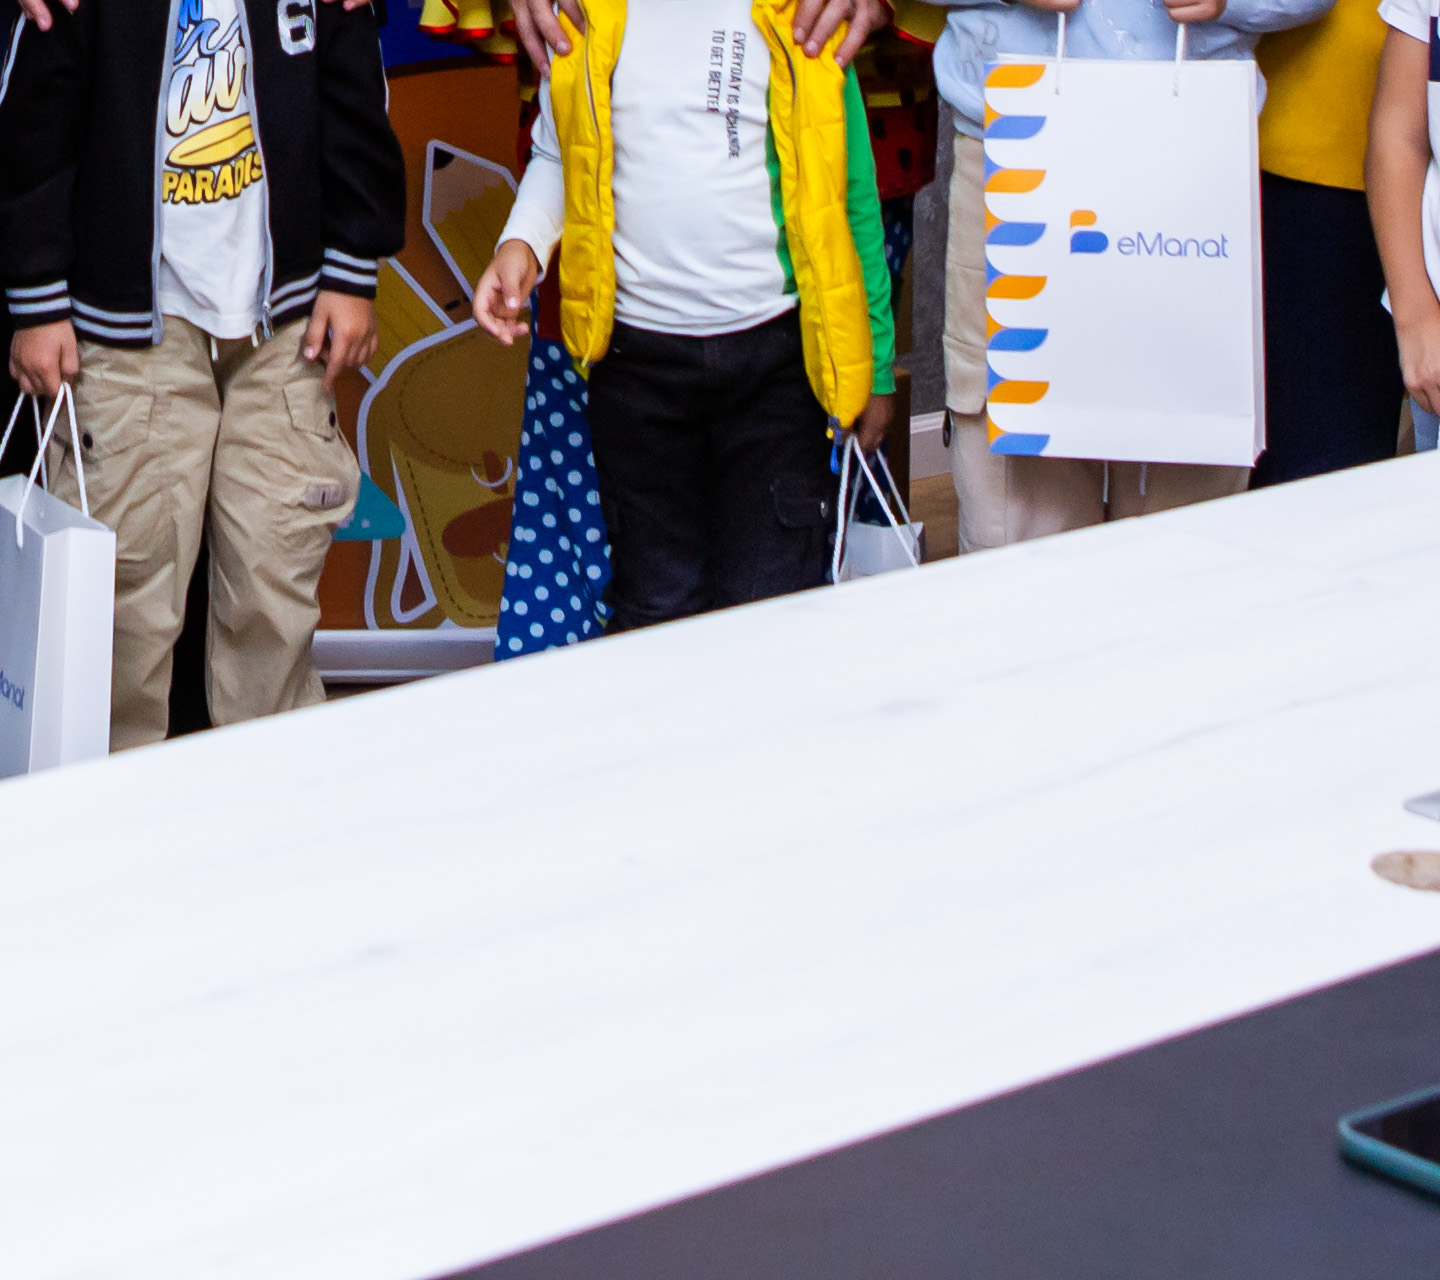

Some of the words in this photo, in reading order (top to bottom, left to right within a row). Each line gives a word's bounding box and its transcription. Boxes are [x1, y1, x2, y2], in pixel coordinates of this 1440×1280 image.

[712, 29, 726, 44] TO
[710, 45, 724, 68] GET
[1117, 230, 1229, 260] eManat
